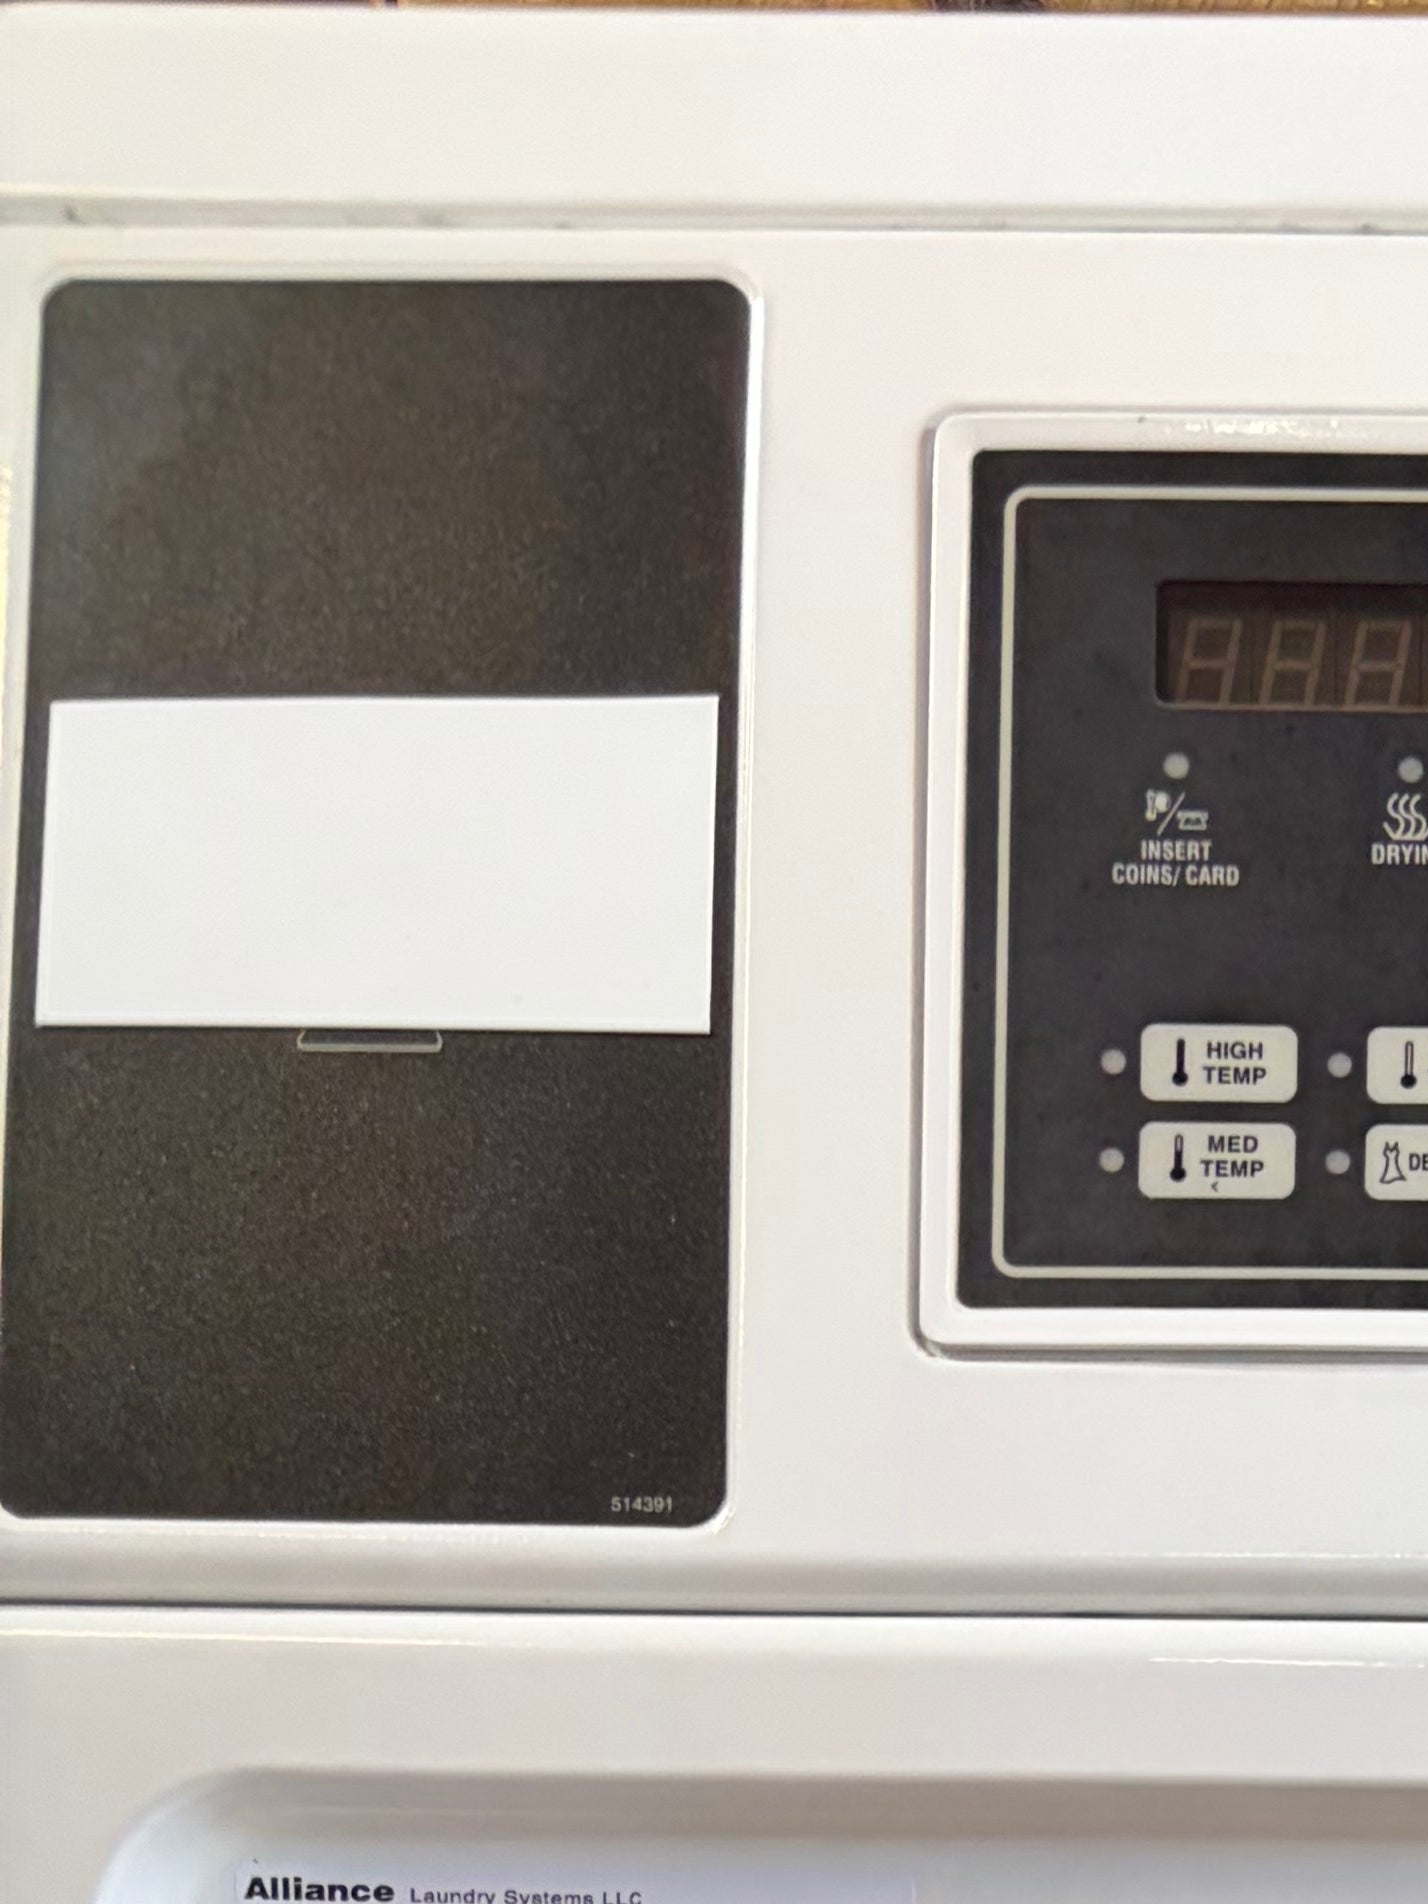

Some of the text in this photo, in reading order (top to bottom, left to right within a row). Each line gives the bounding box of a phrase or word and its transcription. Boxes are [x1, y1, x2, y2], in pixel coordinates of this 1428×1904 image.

[1141, 840, 1211, 860] INSERT
[1186, 864, 1239, 886] CARD
[1207, 1042, 1262, 1059] HIGH
[1203, 1066, 1266, 1084] TEMP
[1208, 1136, 1258, 1153] MED
[1201, 1160, 1264, 1177] TEMP
[611, 1496, 672, 1512] 514391
[245, 1877, 394, 1902] Alliance
